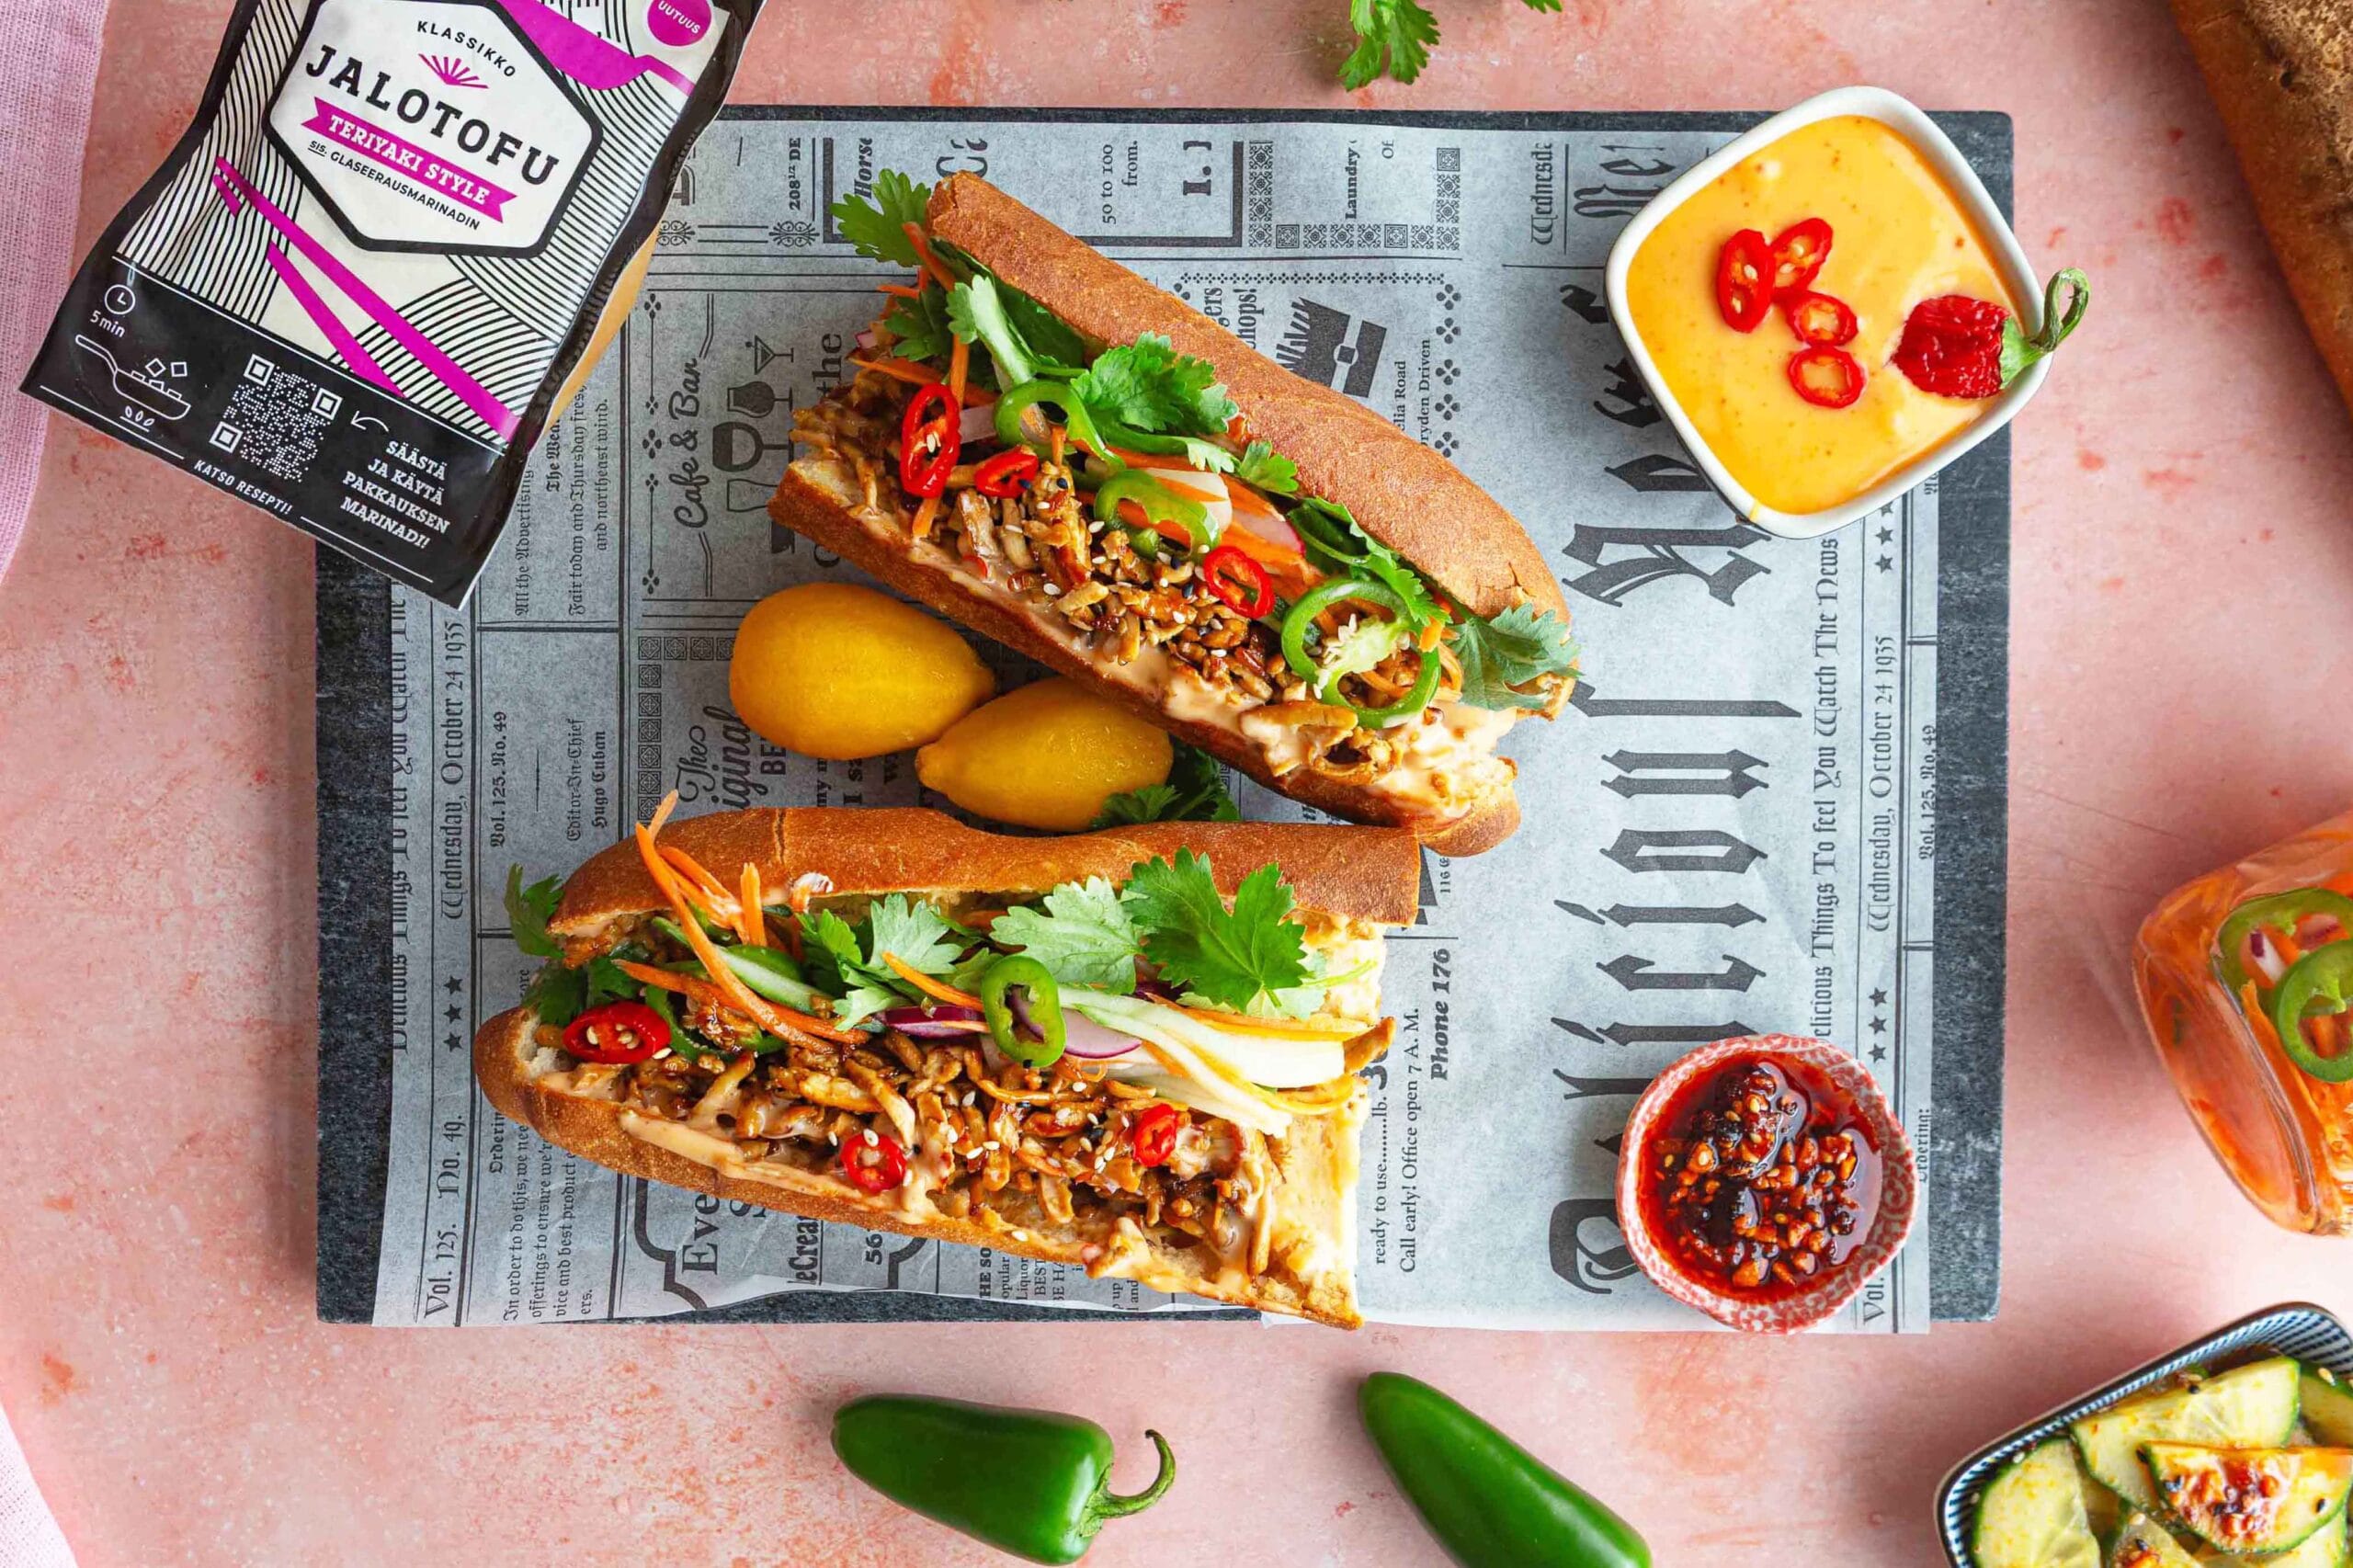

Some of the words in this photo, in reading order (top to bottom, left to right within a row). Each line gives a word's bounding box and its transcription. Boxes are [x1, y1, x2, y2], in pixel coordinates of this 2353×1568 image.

[657, 0, 701, 34] UUTUUS
[417, 20, 516, 77] KLASSIKKO
[305, 43, 560, 185] JALOTOFU
[328, 115, 426, 172] TERIYAKI
[425, 164, 491, 205] STYLE
[1101, 144, 1113, 176] 100
[309, 140, 328, 156] SIS.
[329, 150, 481, 231] GLASEERAUSMARINADIN
[1100, 181, 1113, 199] to
[1344, 147, 1360, 220] Laundry
[1101, 204, 1117, 225] 50
[1233, 288, 1265, 349] hops!
[1394, 360, 1406, 399] Road
[1418, 338, 1431, 392] Driven
[668, 358, 700, 420] Bar
[546, 419, 561, 459] Wea
[595, 399, 608, 445] wind.
[669, 429, 699, 451] &
[368, 458, 389, 478] JA
[391, 469, 445, 506] KÄYTÄ
[386, 440, 448, 481] SÄÄSTÄ
[546, 463, 563, 493] The
[570, 426, 586, 501] Thursday
[194, 460, 235, 486] KATSO
[235, 481, 293, 515] RESEPTI!
[342, 471, 450, 534] PAKKAUKSEN
[595, 447, 610, 519] northeast
[668, 457, 710, 528] Cafe
[340, 496, 430, 549] MARINADI!
[570, 504, 584, 531] and
[594, 523, 608, 551] and
[515, 566, 532, 589] the
[569, 536, 585, 580] today
[1814, 538, 1839, 606] News
[568, 582, 585, 616] Fair
[443, 620, 470, 662] 1935
[1813, 613, 1840, 658] The
[1875, 635, 1897, 675] 1935
[444, 669, 464, 691] 24
[1813, 665, 1843, 737] Watch
[1875, 684, 1893, 704] 24
[439, 698, 464, 786] October
[493, 711, 506, 732] 49
[676, 725, 715, 802] The
[703, 706, 768, 810] iginal
[760, 737, 786, 775] BE
[1813, 746, 1842, 792] You
[1869, 712, 1893, 798] October
[492, 771, 506, 806] 125.
[591, 788, 608, 829] Hugo
[440, 795, 469, 920] Wednesday,
[1812, 841, 1836, 875] To
[1867, 807, 1895, 932] Wednesday,
[1809, 882, 1838, 959] Things
[1432, 948, 1451, 994] 176
[1404, 1007, 1419, 1032] M.
[1810, 966, 1833, 1040] elicious
[1404, 1039, 1419, 1059] A.
[1430, 1001, 1449, 1081] Phone
[1408, 1064, 1422, 1074] 7
[1405, 1081, 1421, 1121] open
[489, 1111, 505, 1174] Orderin
[517, 1125, 529, 1150] nee
[1401, 1127, 1417, 1179] Office
[437, 1152, 460, 1199] No.
[517, 1154, 528, 1176] we
[512, 1178, 529, 1211] this,
[537, 1180, 551, 1230] ensure
[561, 1163, 575, 1220] product
[1373, 1196, 1386, 1212] to
[1400, 1185, 1421, 1233] early!
[435, 1223, 458, 1259] 125.
[508, 1236, 522, 1251] to
[533, 1234, 548, 1250] to
[558, 1224, 573, 1256] best
[682, 1194, 721, 1276] Eve
[1370, 1218, 1390, 1265] ready
[1399, 1237, 1416, 1273] Call
[423, 1271, 453, 1318] Vol.
[506, 1255, 521, 1295] order
[529, 1253, 550, 1318] offerings
[556, 1259, 571, 1287] and
[997, 1256, 1014, 1300] opular
[580, 1289, 593, 1314] ers.
